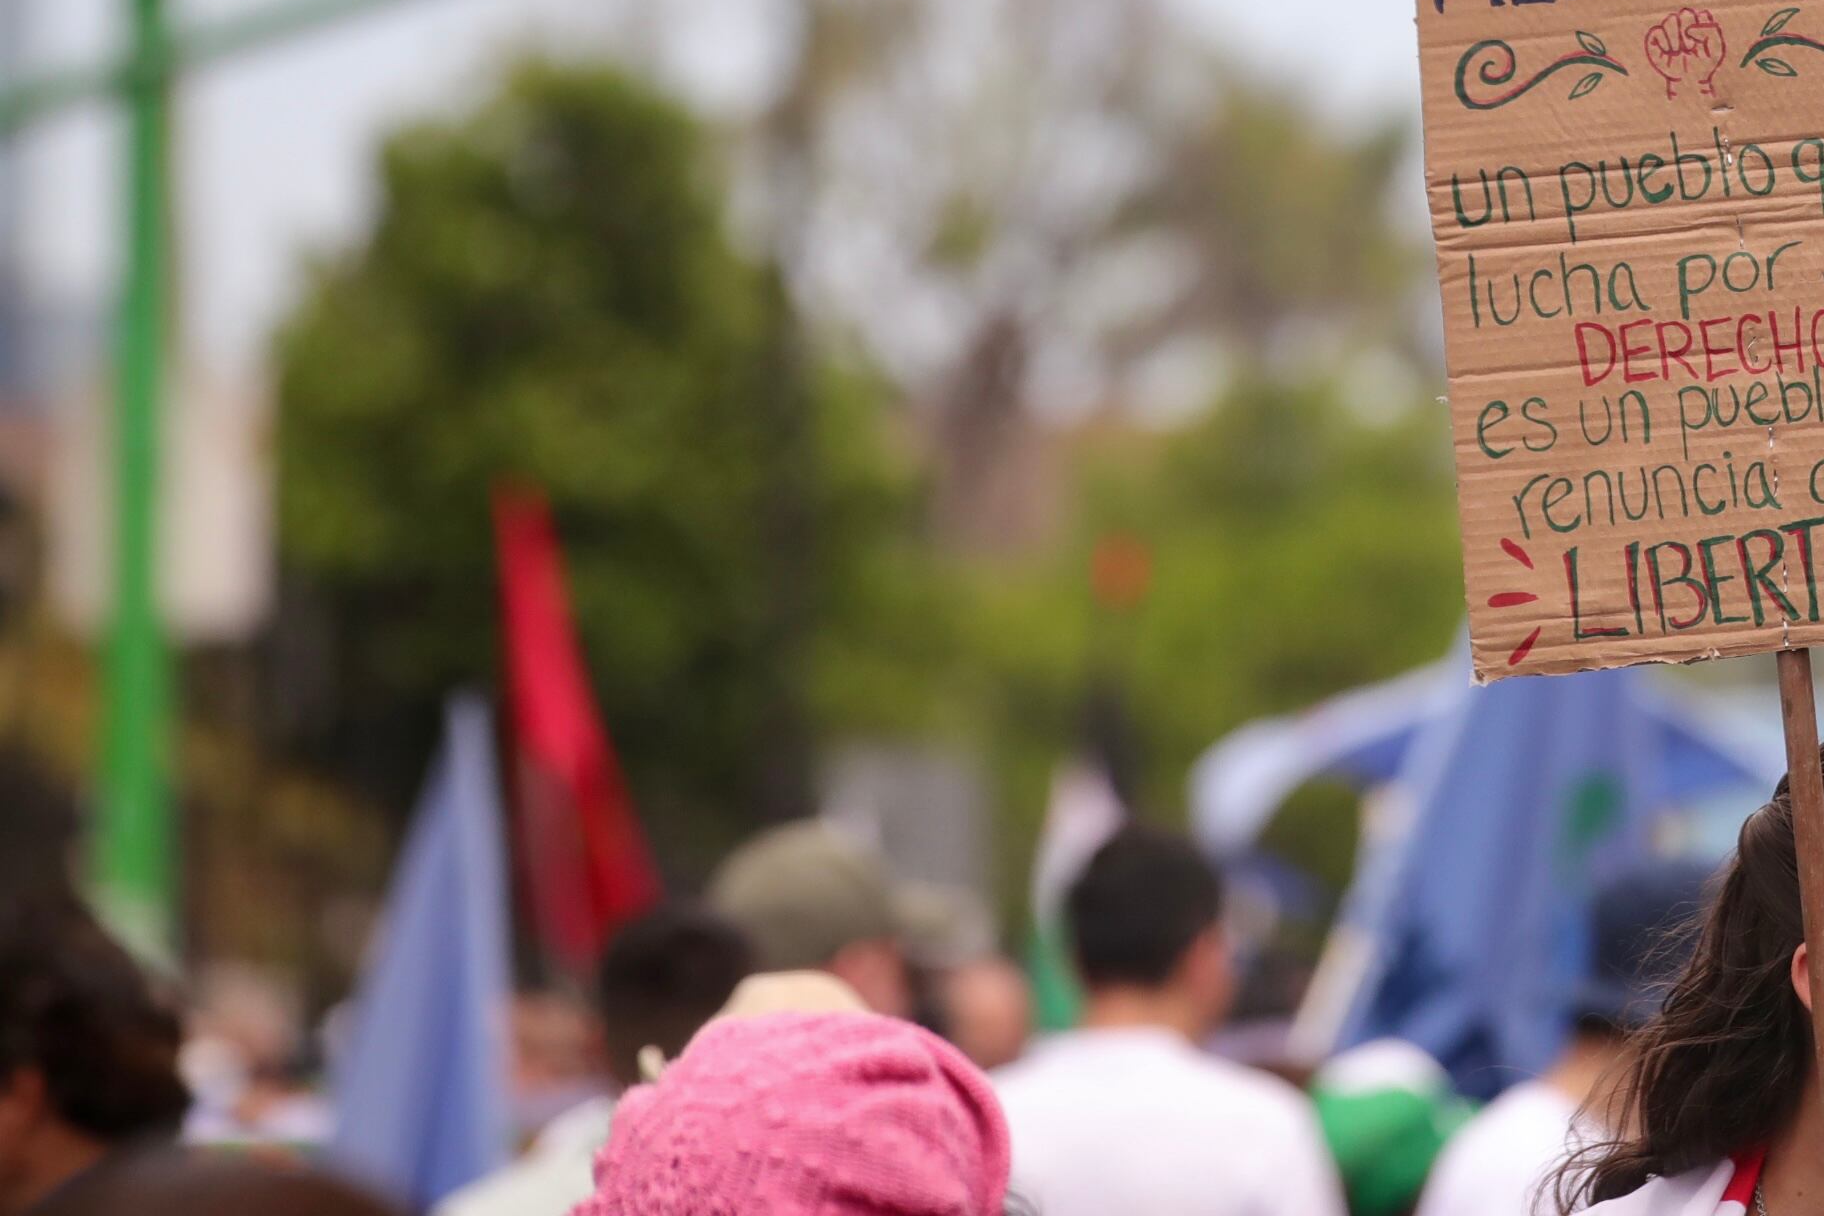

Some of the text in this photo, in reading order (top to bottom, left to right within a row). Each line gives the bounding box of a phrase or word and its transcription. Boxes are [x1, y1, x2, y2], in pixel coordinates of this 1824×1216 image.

[1451, 165, 1534, 228] un
[1560, 125, 1776, 244] pueblo
[1467, 253, 1648, 328] lucha
[1677, 240, 1802, 319] por
[1476, 396, 1558, 458] es
[1579, 388, 1651, 446] un
[1512, 450, 1782, 539] renuncia
